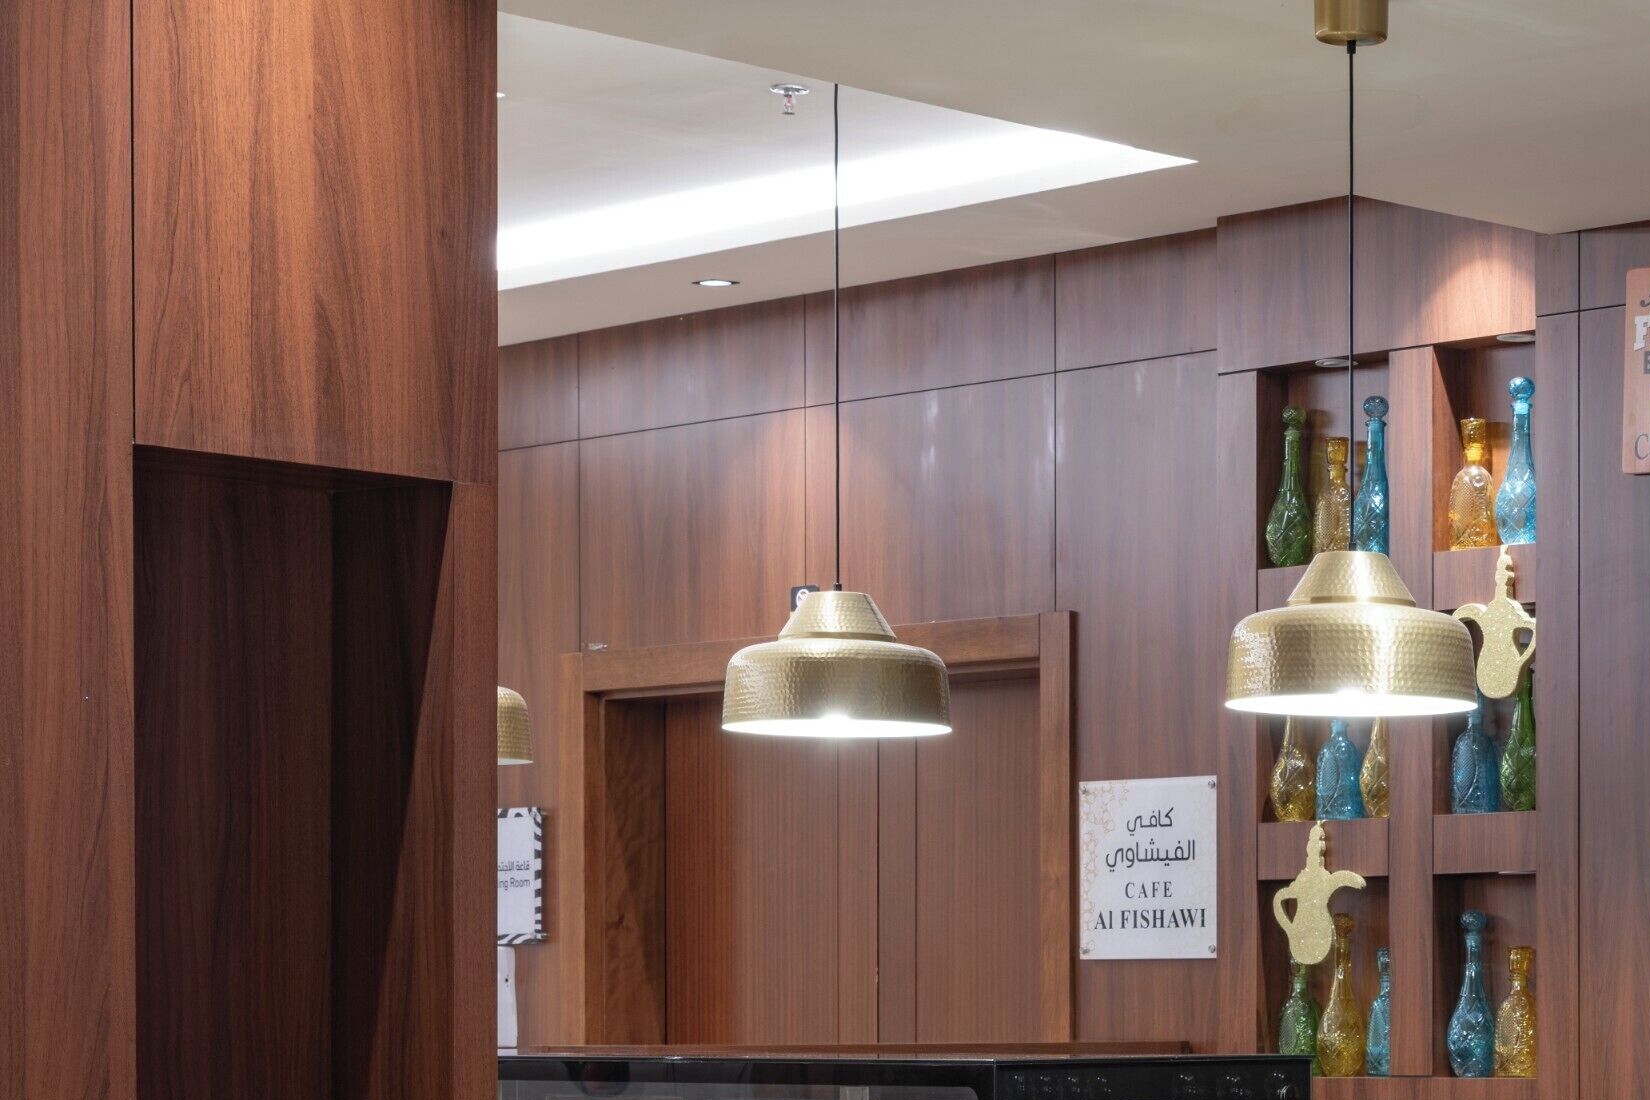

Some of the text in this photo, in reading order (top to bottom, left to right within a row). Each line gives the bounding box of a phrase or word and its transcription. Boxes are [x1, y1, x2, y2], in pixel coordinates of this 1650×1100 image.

[1126, 806, 1174, 836] كافي
[1105, 838, 1196, 873] الفيشاوي
[510, 877, 530, 888] Room
[1125, 881, 1173, 899] CAFE
[1119, 908, 1207, 929] FISHAWI
